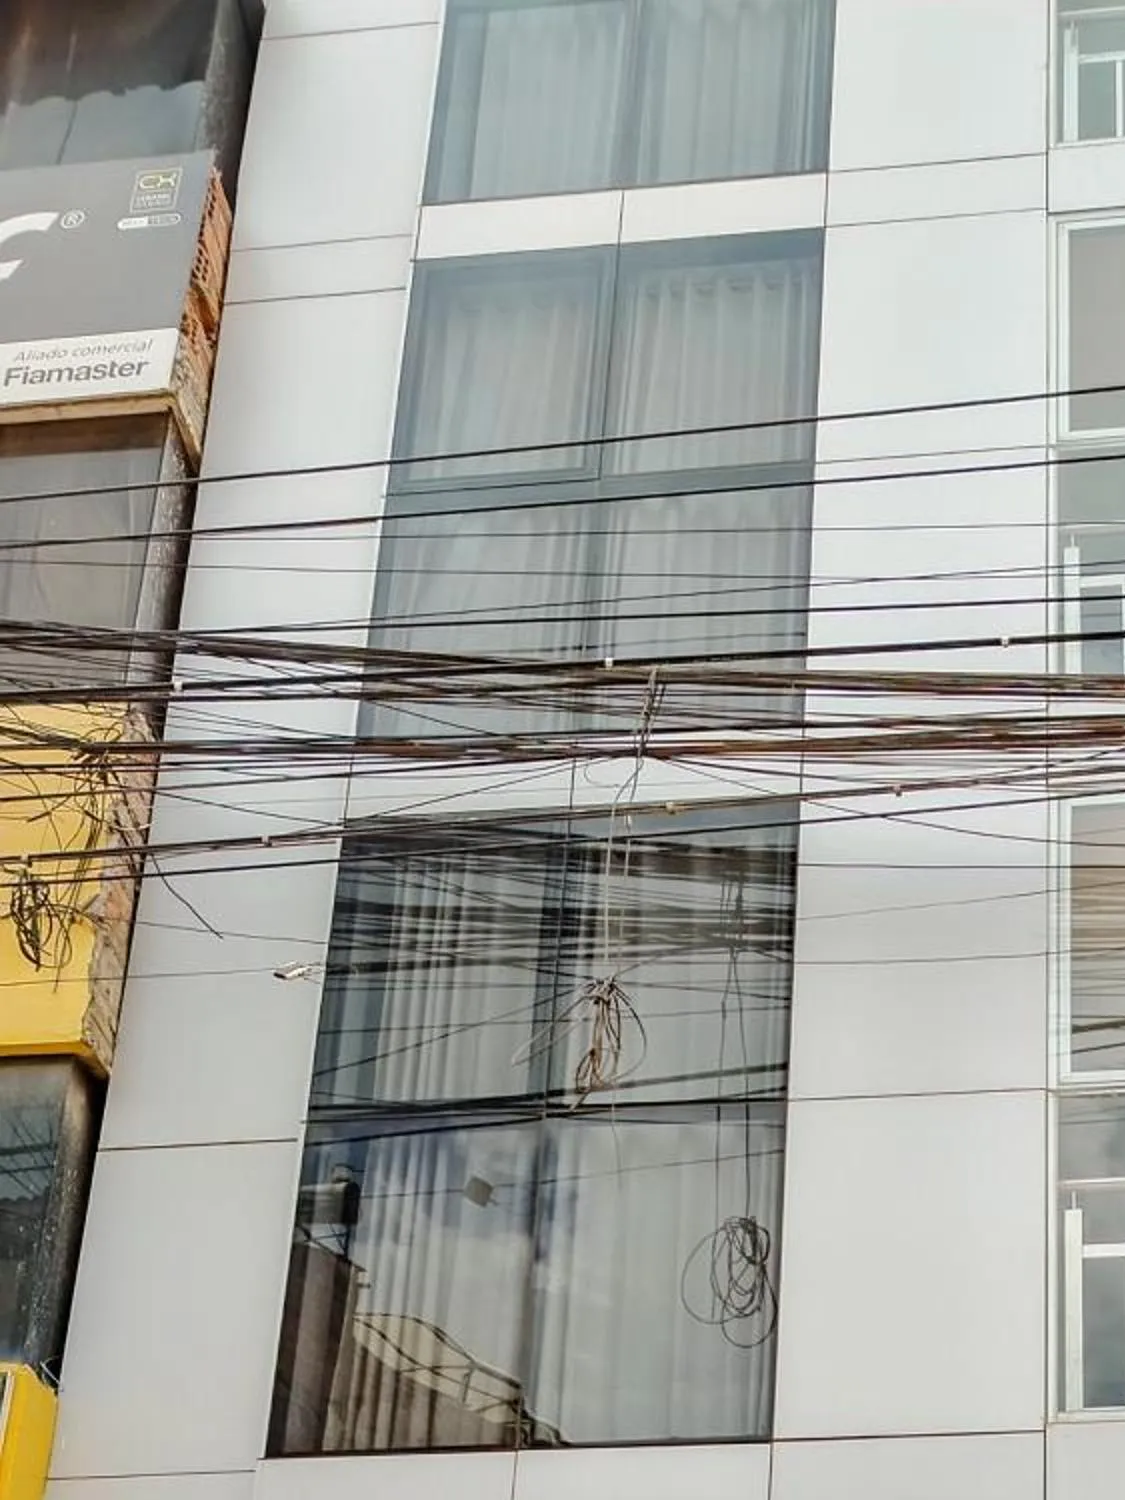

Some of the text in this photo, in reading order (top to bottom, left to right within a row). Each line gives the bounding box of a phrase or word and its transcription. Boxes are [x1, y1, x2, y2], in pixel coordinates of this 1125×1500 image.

[14, 338, 153, 362] Aliado comercial
[3, 360, 150, 387] Fiamaster
